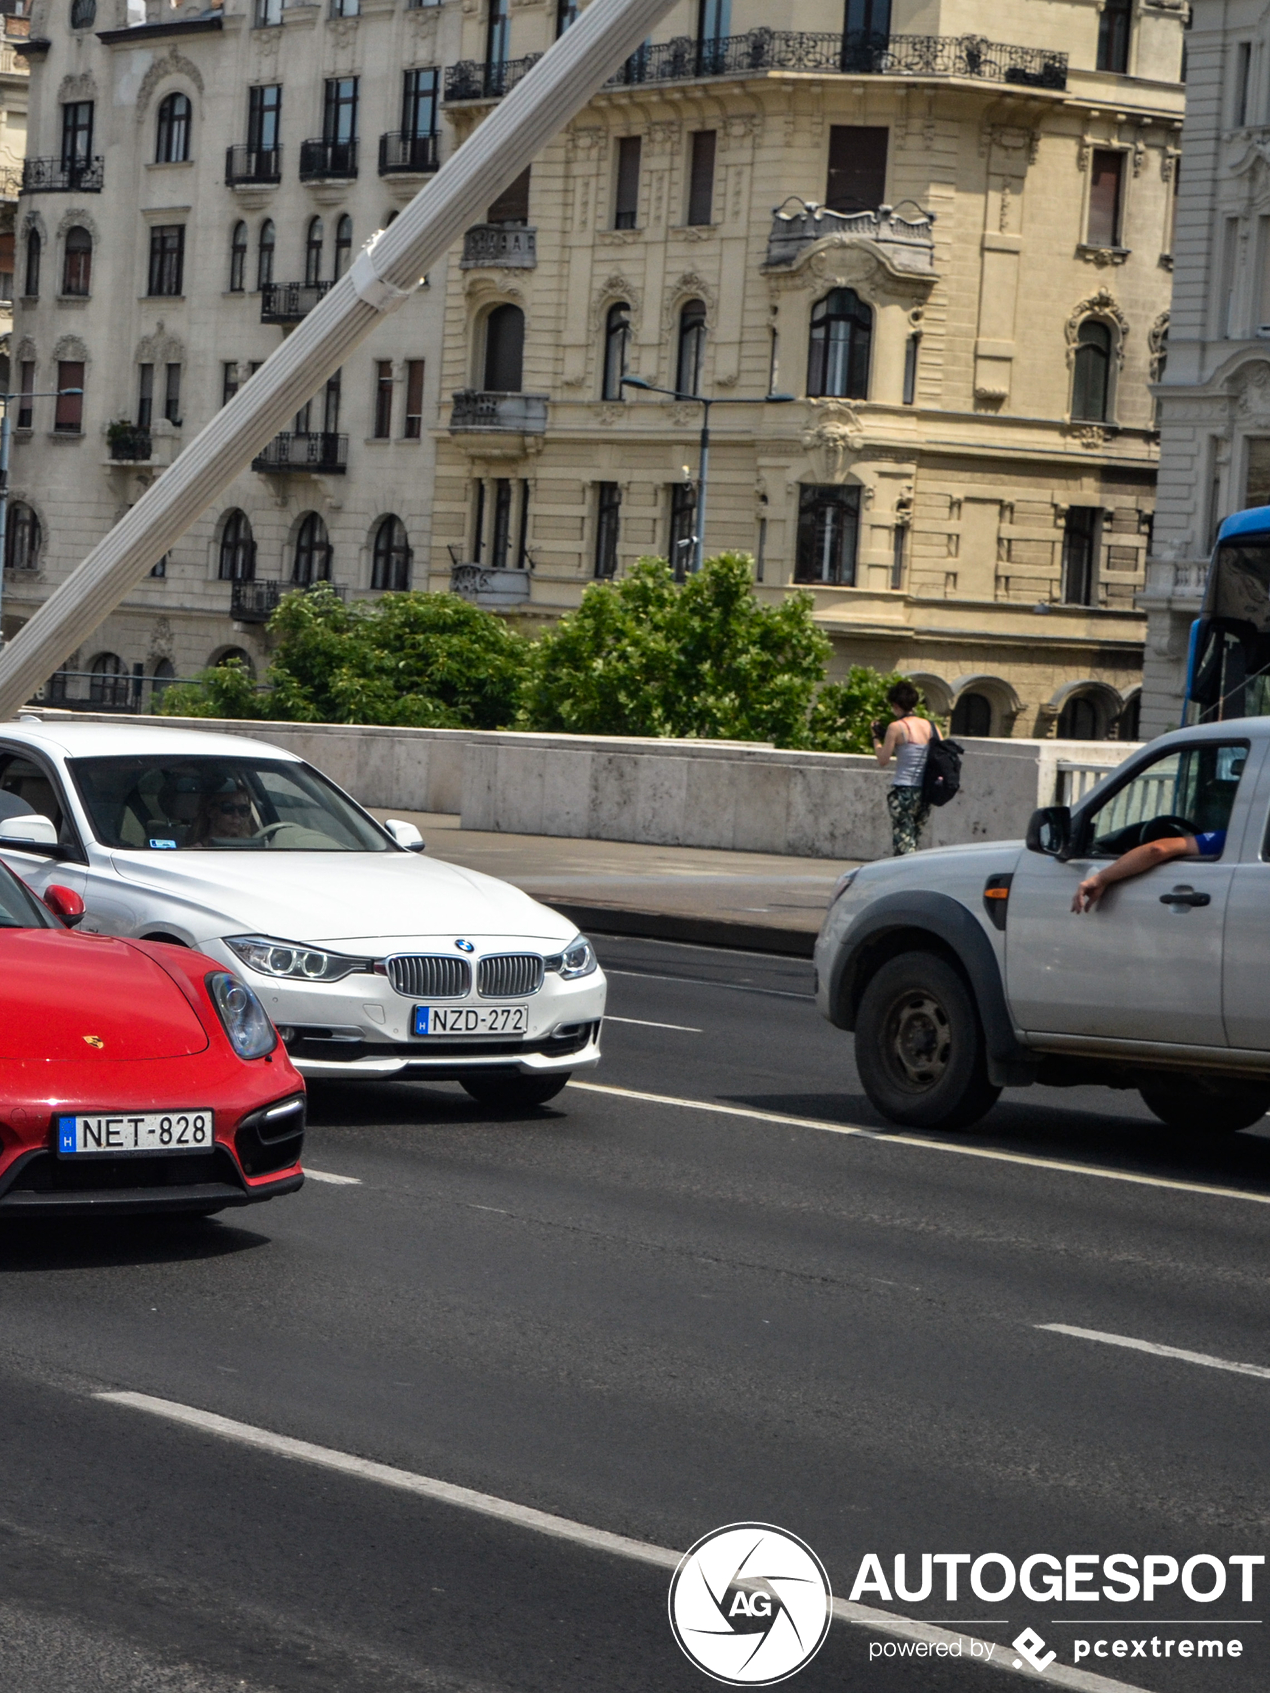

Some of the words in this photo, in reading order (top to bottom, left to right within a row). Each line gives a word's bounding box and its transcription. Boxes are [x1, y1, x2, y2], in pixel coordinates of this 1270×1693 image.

[433, 1009, 523, 1031] NZD-272
[63, 1136, 72, 1146] H
[82, 1114, 206, 1148] NET-828
